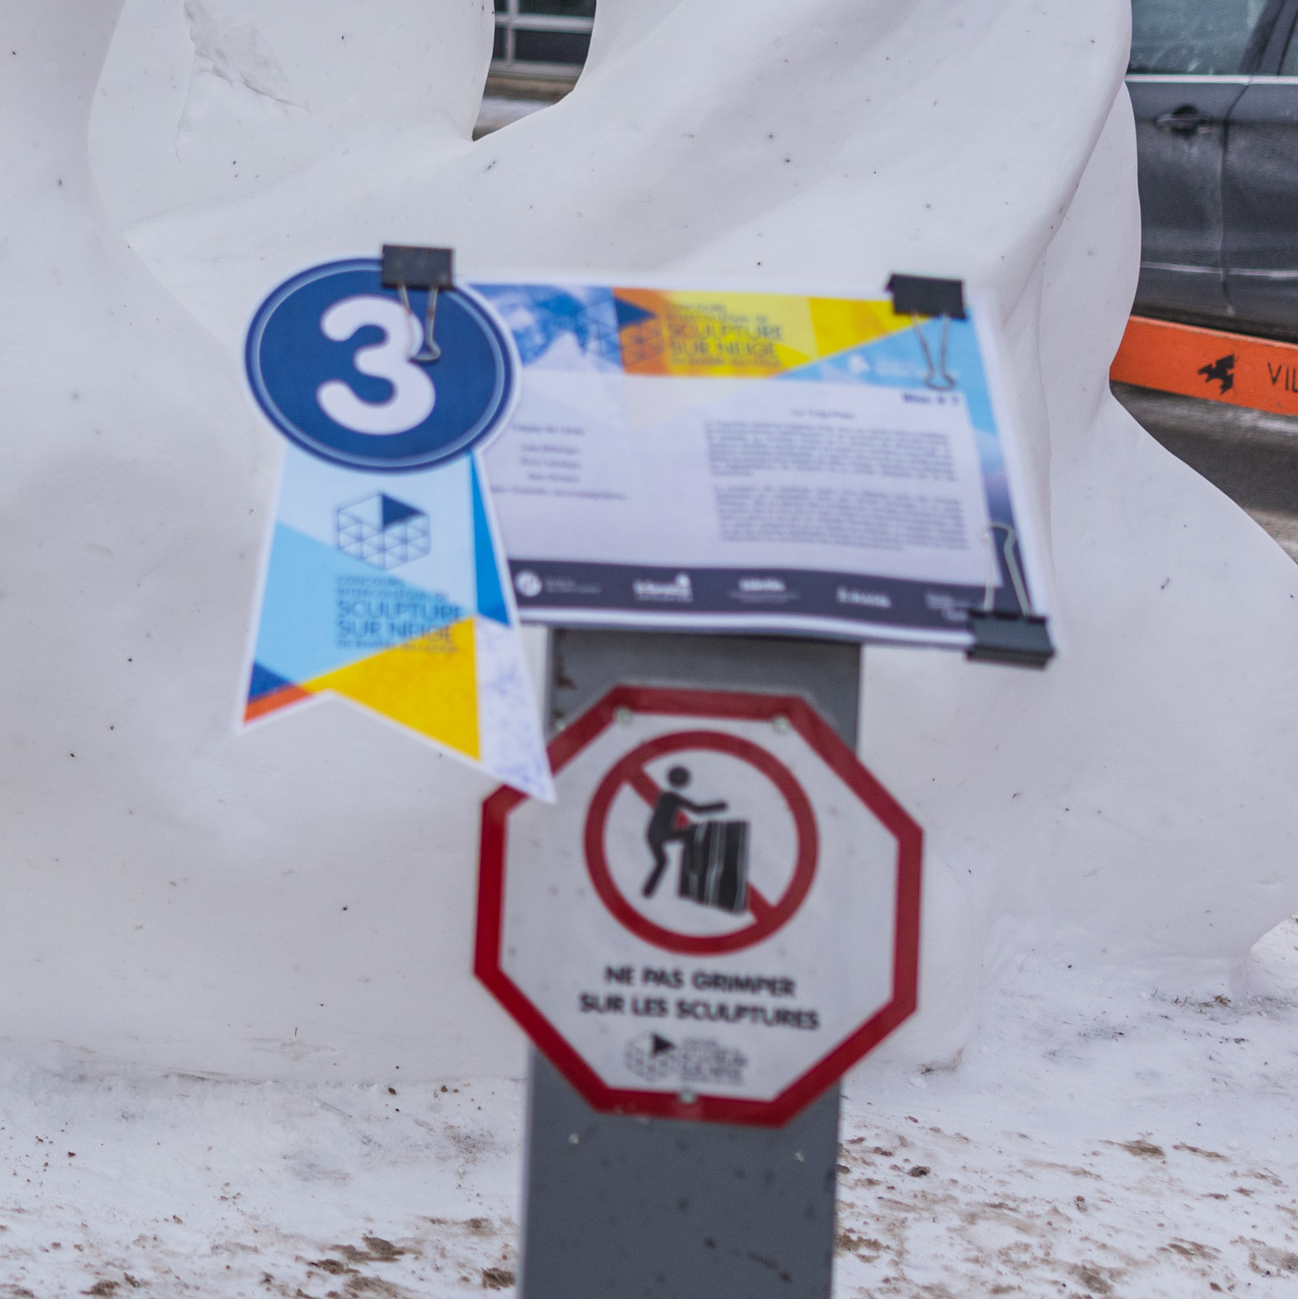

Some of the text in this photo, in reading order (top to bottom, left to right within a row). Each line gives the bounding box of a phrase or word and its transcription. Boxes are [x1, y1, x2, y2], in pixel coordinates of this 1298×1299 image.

[668, 324, 782, 340] SCULPTURE
[670, 340, 775, 357] SUR NEIGE
[316, 294, 436, 436] 3
[338, 600, 464, 621] SCULPTURE
[338, 621, 452, 642] SUR NEIGE
[604, 966, 796, 997] NE PAS GRIMPER
[579, 993, 820, 1030] SUR LES SCULPTURES
